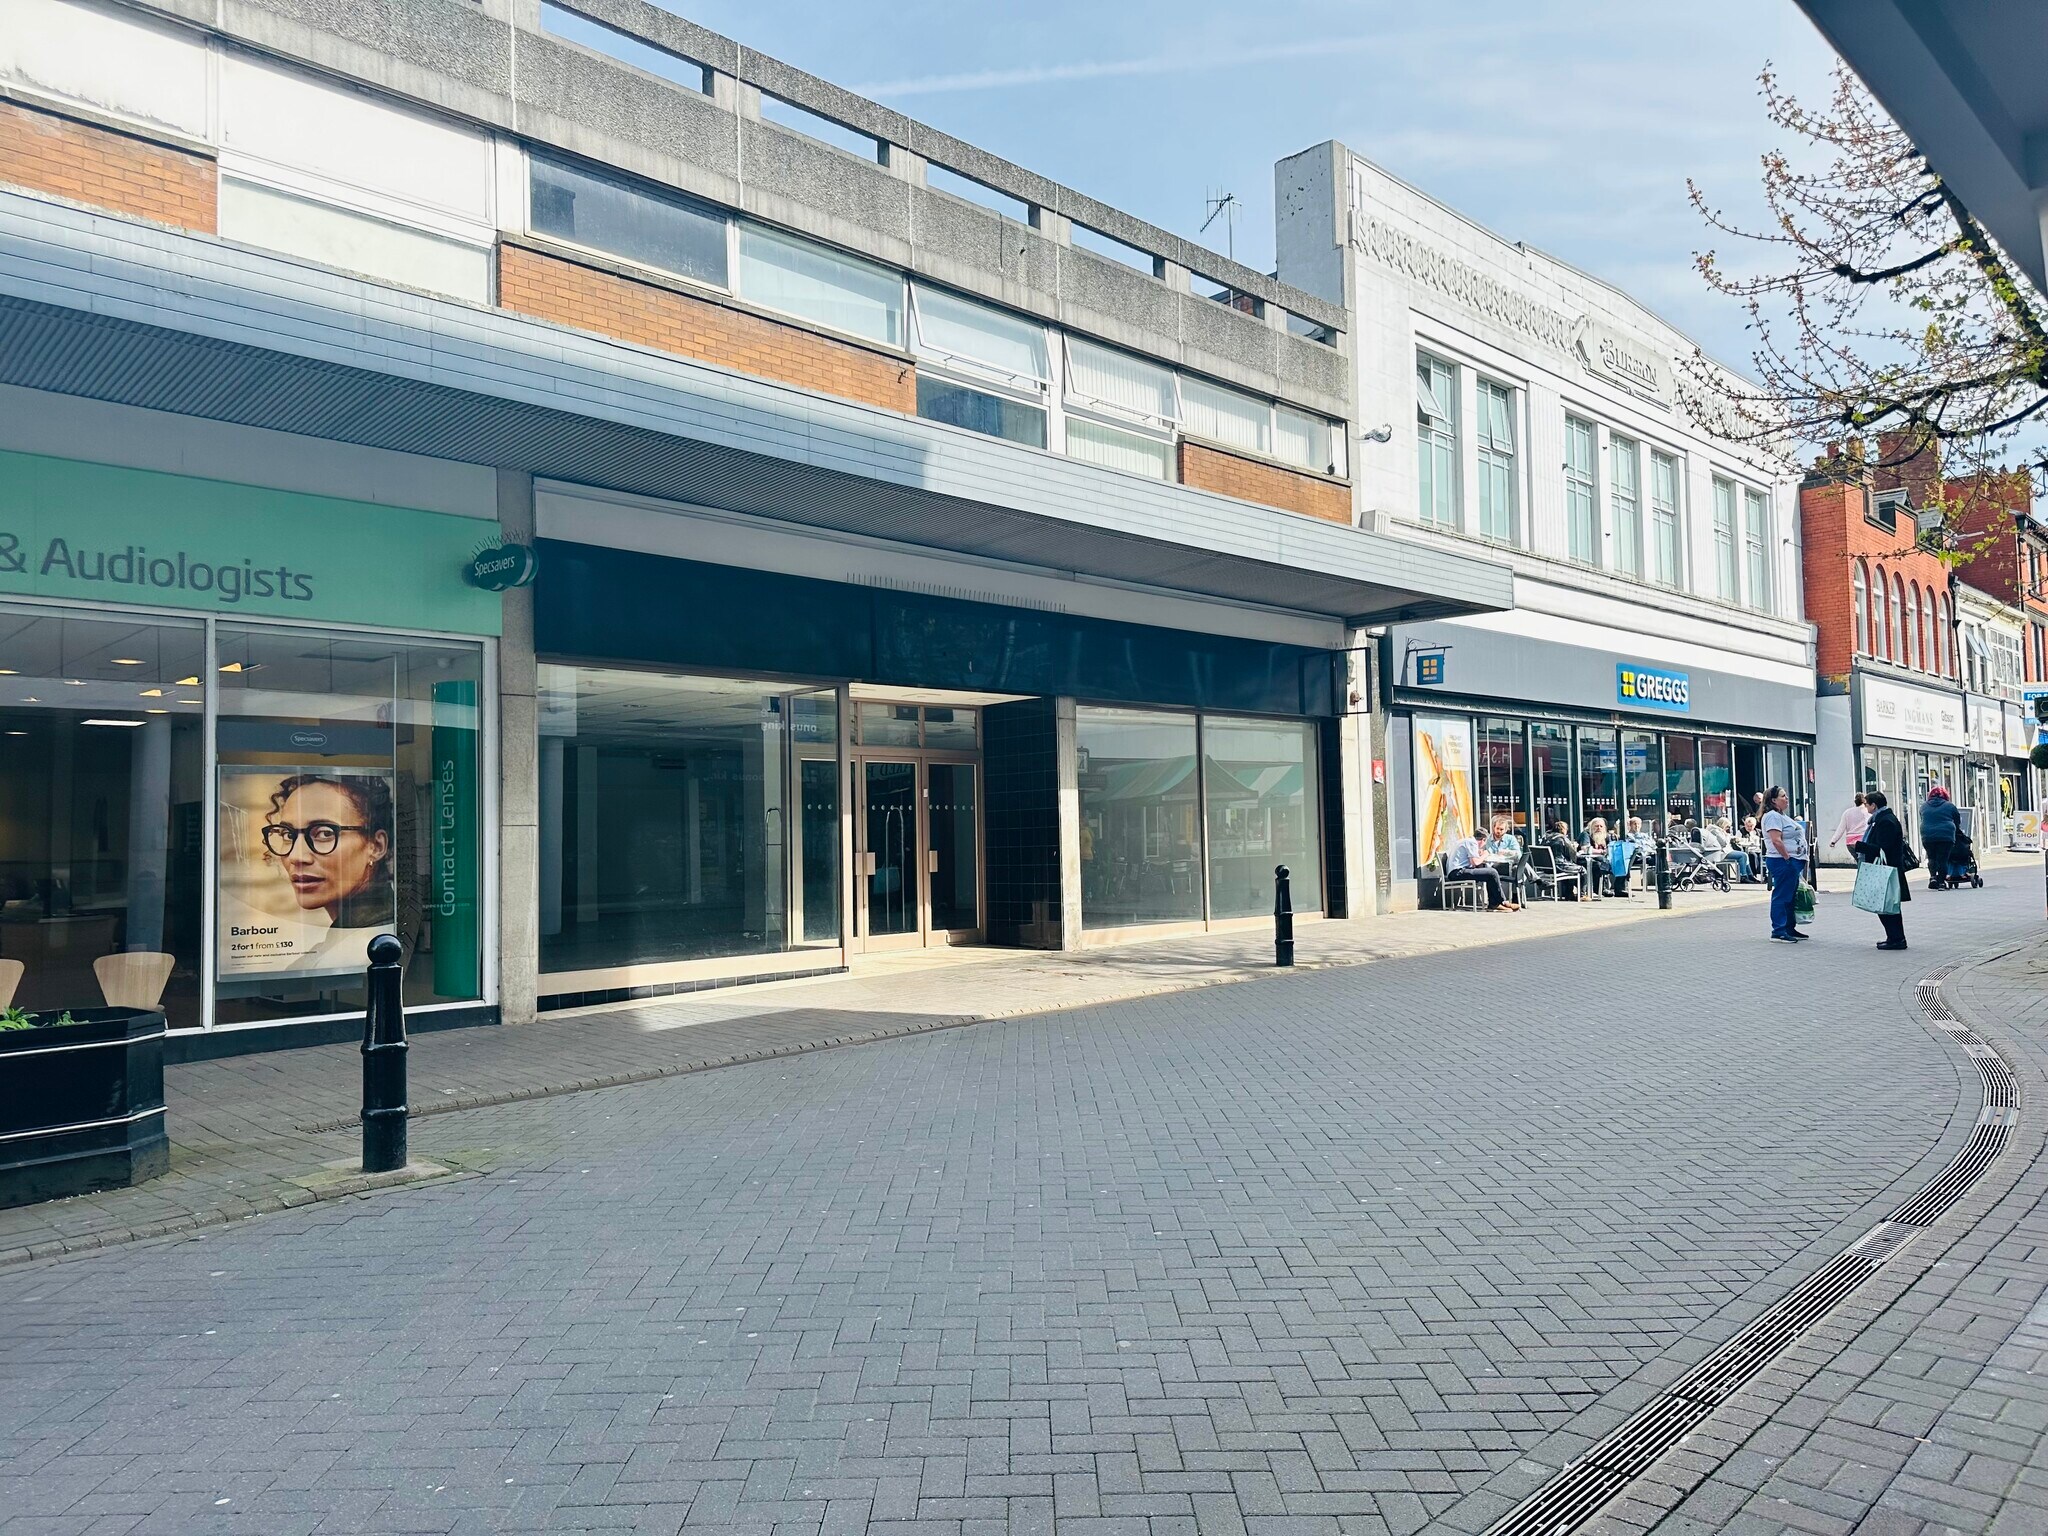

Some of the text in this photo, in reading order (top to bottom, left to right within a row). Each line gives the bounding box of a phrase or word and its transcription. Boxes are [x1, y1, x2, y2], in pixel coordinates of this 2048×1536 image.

[0, 532, 313, 603] & Audiologists
[474, 556, 515, 578] Specsavers
[1636, 673, 1689, 703] GREGGS
[1904, 708, 1934, 726] INGMANS
[2016, 814, 2038, 833] £2
[440, 760, 455, 916] Contact Lenses
[231, 926, 279, 936] Barbour
